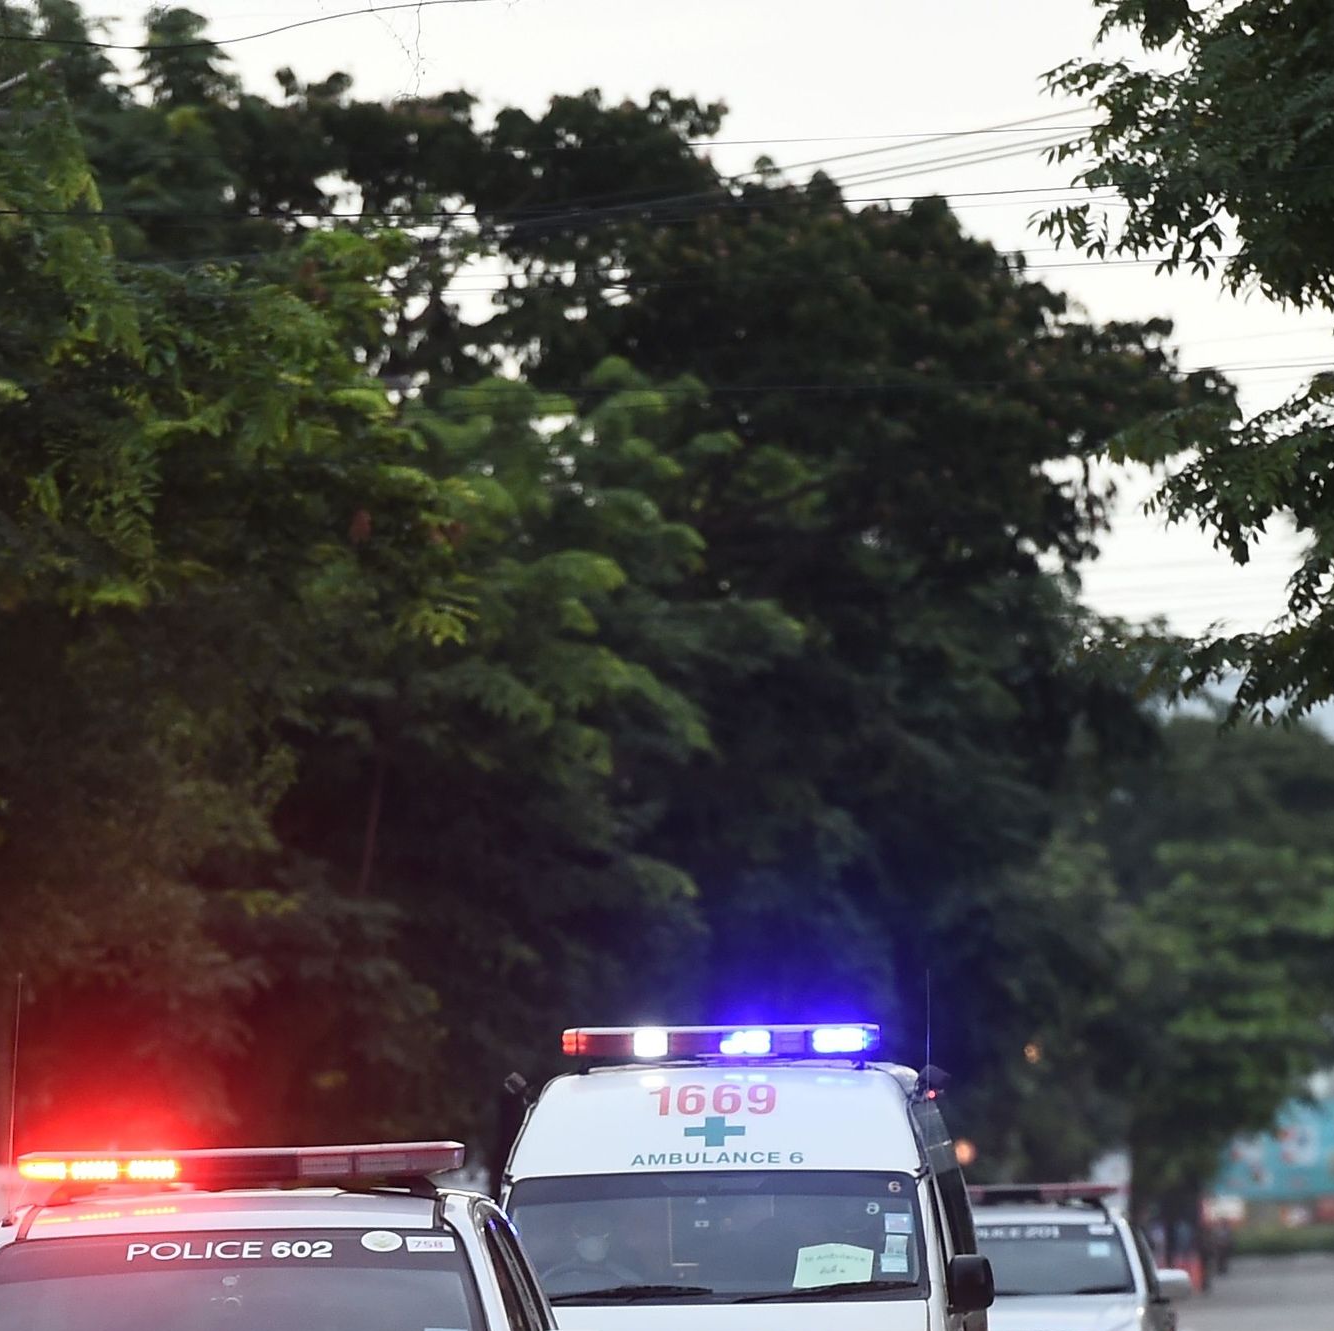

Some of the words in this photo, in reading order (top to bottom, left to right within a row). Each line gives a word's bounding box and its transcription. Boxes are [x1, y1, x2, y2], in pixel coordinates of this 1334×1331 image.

[649, 1084, 777, 1116] 1669
[631, 1152, 781, 1166] AMBULANCE
[789, 1152, 804, 1164] 6
[888, 1181, 901, 1193] 6
[126, 1241, 264, 1261] POLICE
[271, 1241, 333, 1258] 602
